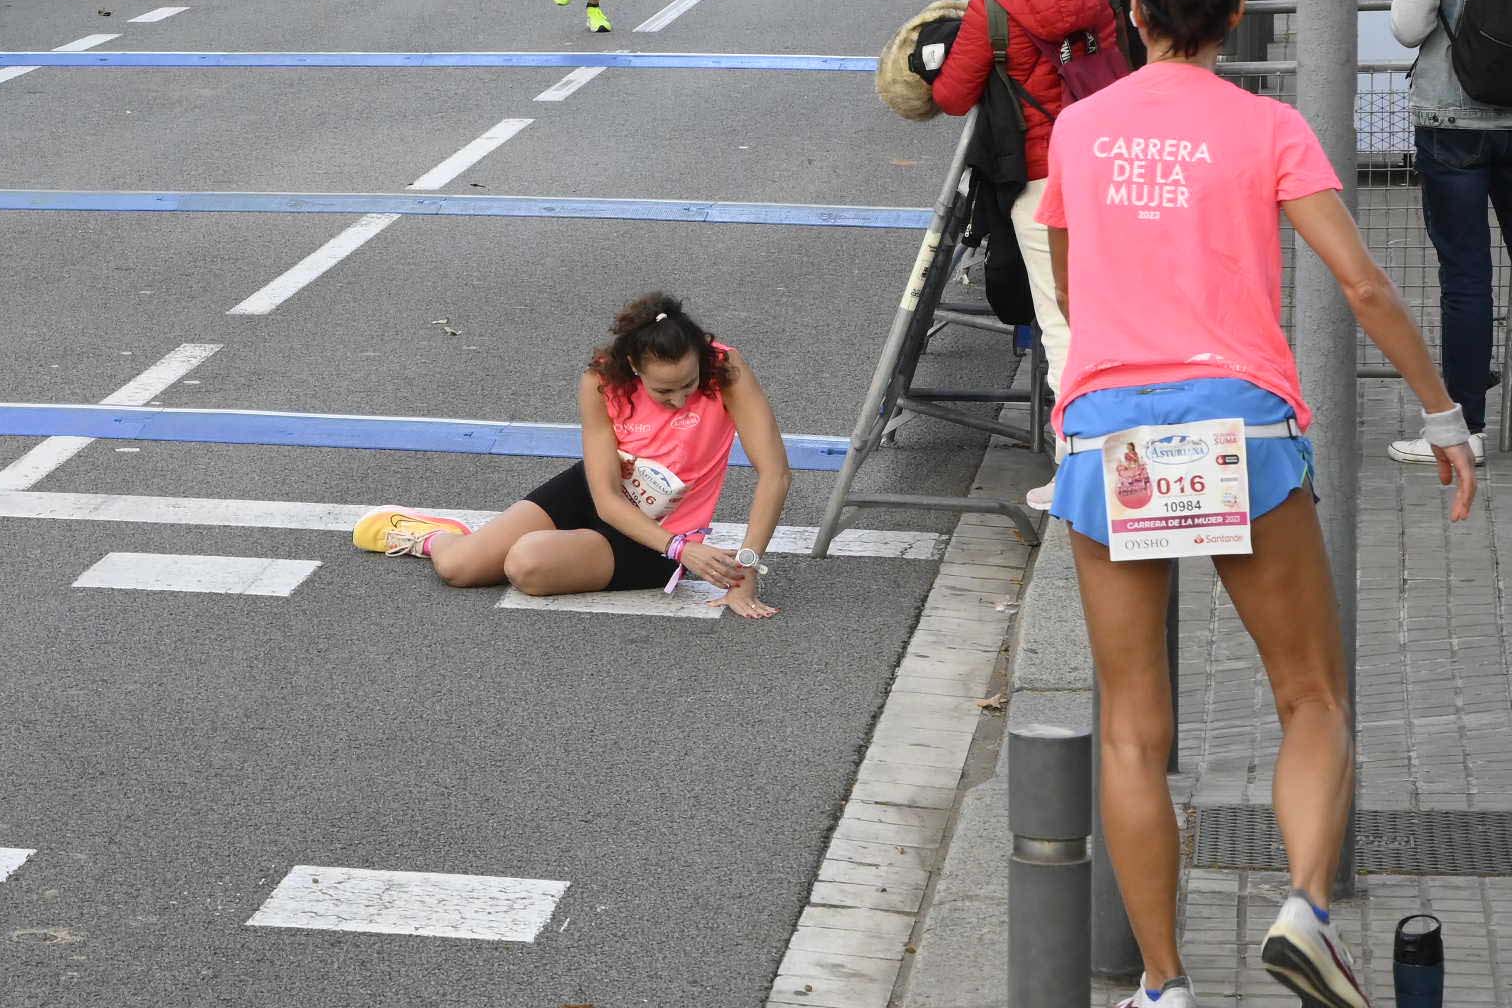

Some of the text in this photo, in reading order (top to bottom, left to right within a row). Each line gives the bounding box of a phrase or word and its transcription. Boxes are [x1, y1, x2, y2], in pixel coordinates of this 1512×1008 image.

[1093, 136, 1212, 163] CARRERA
[1113, 160, 1186, 185] DE LA
[1105, 183, 1190, 209] MUJER
[631, 478, 657, 506] 016
[1156, 475, 1207, 495] 016
[1163, 500, 1202, 513] 10984
[1127, 517, 1167, 530] CARRERA
[1168, 516, 1180, 527] DE
[1181, 515, 1193, 526] LA
[1194, 514, 1223, 525] MUJER
[1124, 537, 1170, 552] OYSHO
